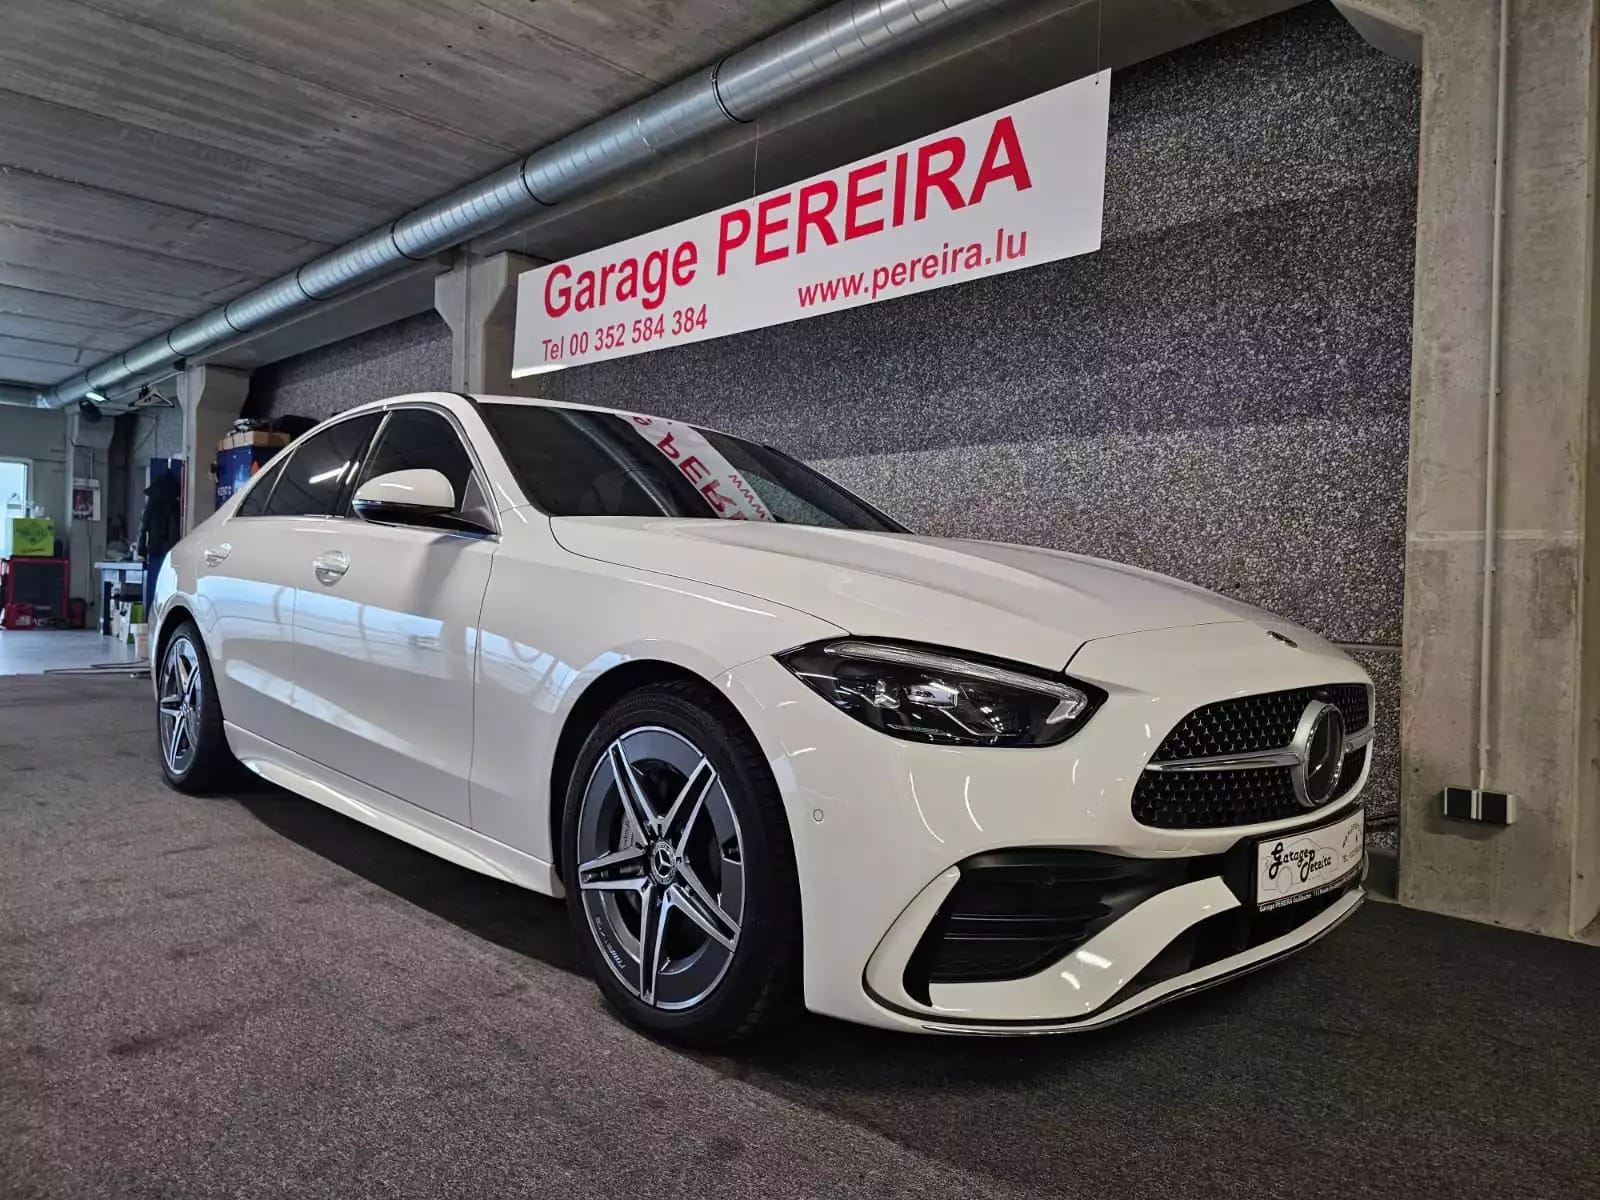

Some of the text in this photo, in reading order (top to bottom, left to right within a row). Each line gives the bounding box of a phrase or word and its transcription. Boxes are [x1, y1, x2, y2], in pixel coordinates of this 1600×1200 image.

[544, 115, 1033, 319] Garage PEREIRA
[797, 228, 1028, 308] www.pereira.lu
[542, 303, 708, 361] Tel 00 352 584 384
[1268, 841, 1310, 880] Garage
[1300, 847, 1332, 883] Pereira
